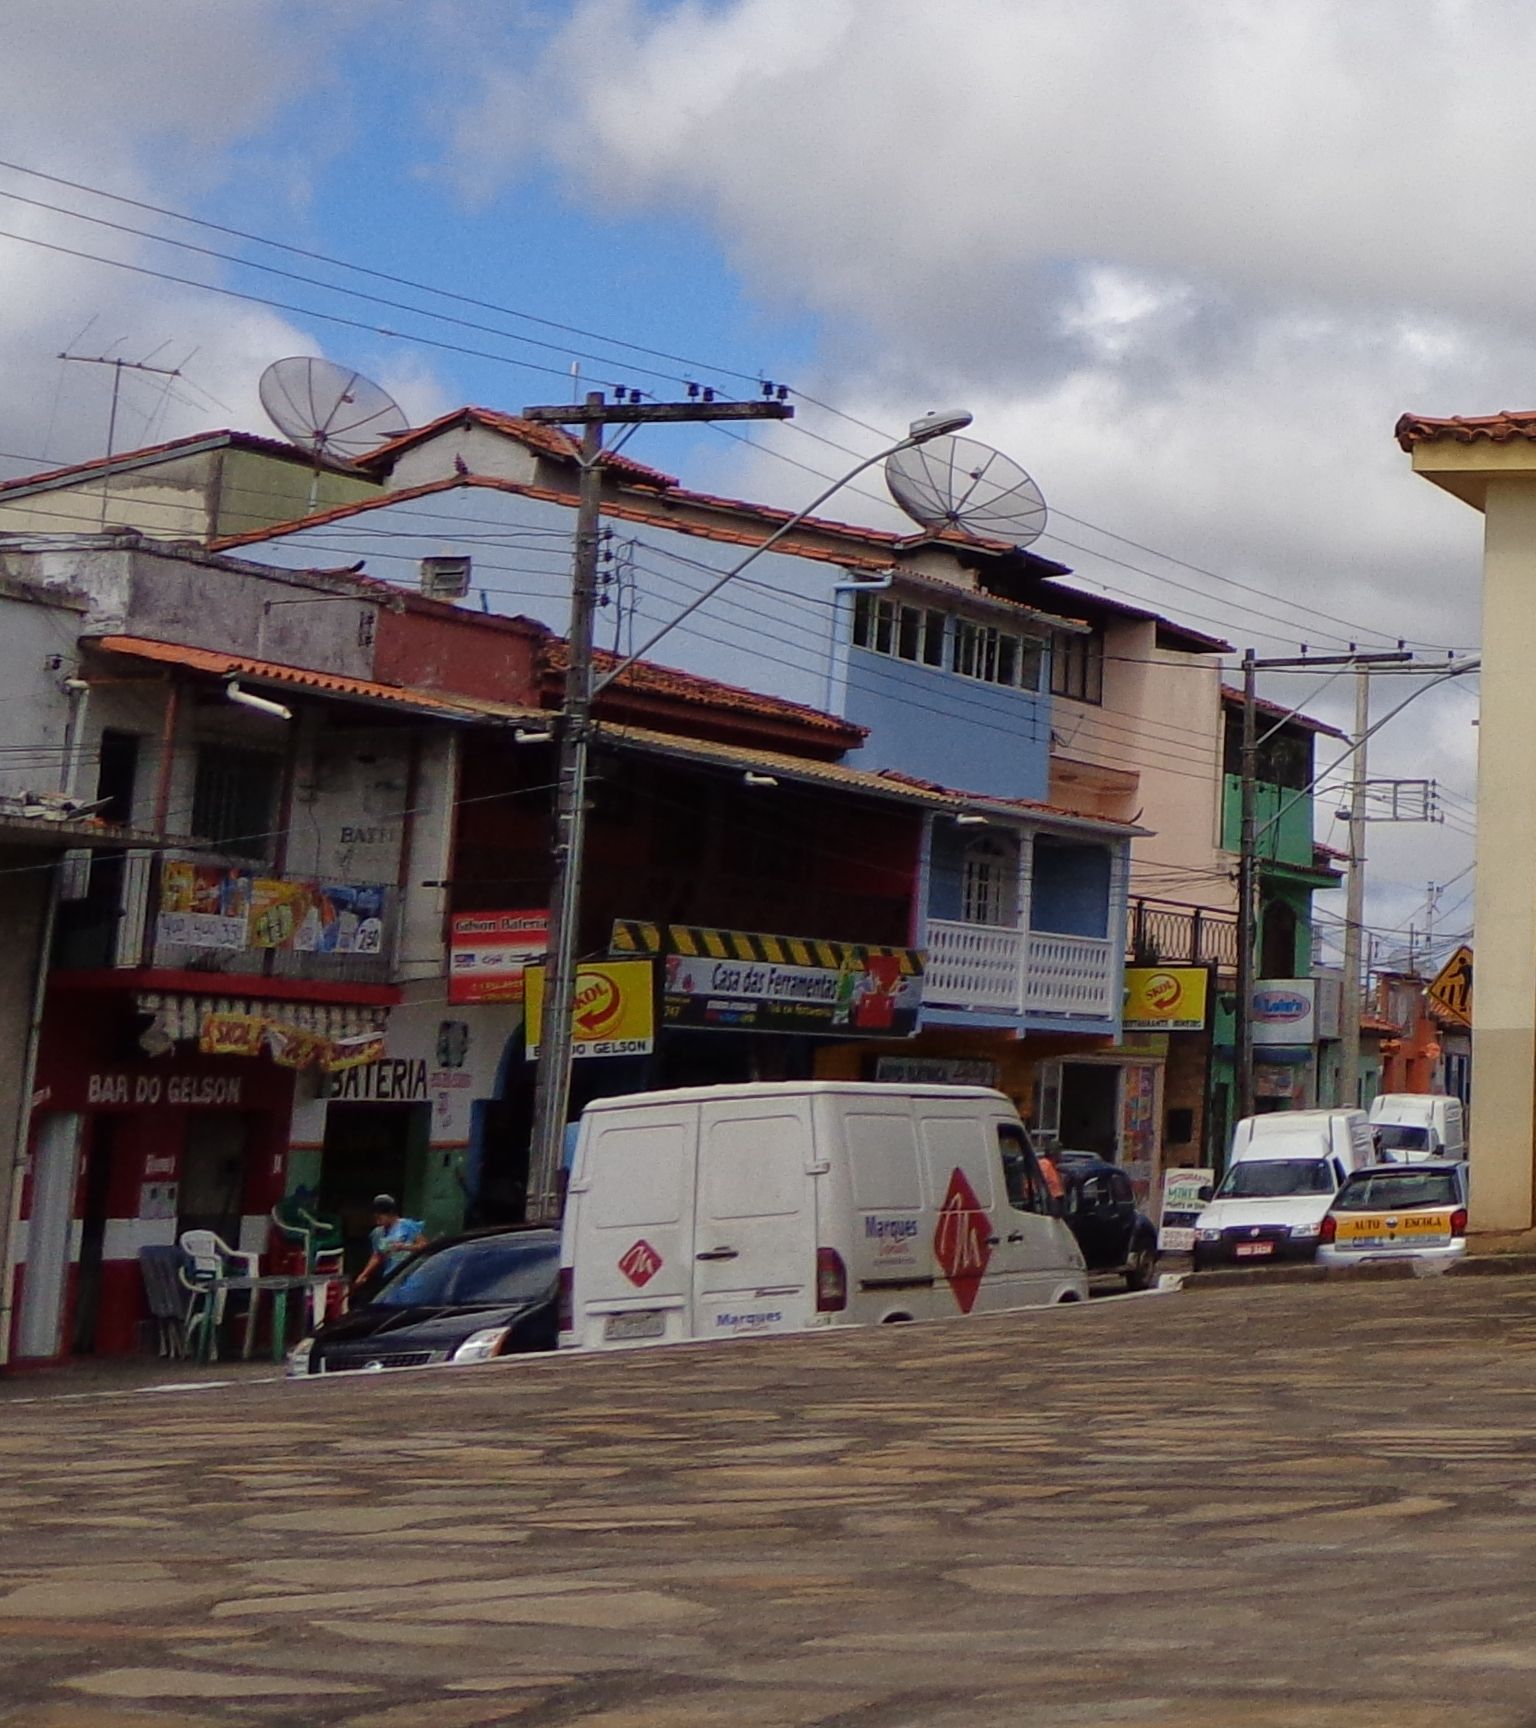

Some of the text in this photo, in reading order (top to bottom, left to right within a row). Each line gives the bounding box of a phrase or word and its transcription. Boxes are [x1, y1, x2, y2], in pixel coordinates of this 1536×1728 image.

[712, 964, 838, 1000] Casa das Ferramentas
[1146, 981, 1174, 1000] SKOL
[593, 1041, 647, 1053] GELSON
[88, 1075, 241, 1103] BAR DO GELSON
[865, 1216, 917, 1243] Marques
[1353, 1217, 1442, 1229] AUTO ESCOLA
[716, 1311, 782, 1328] Marques
